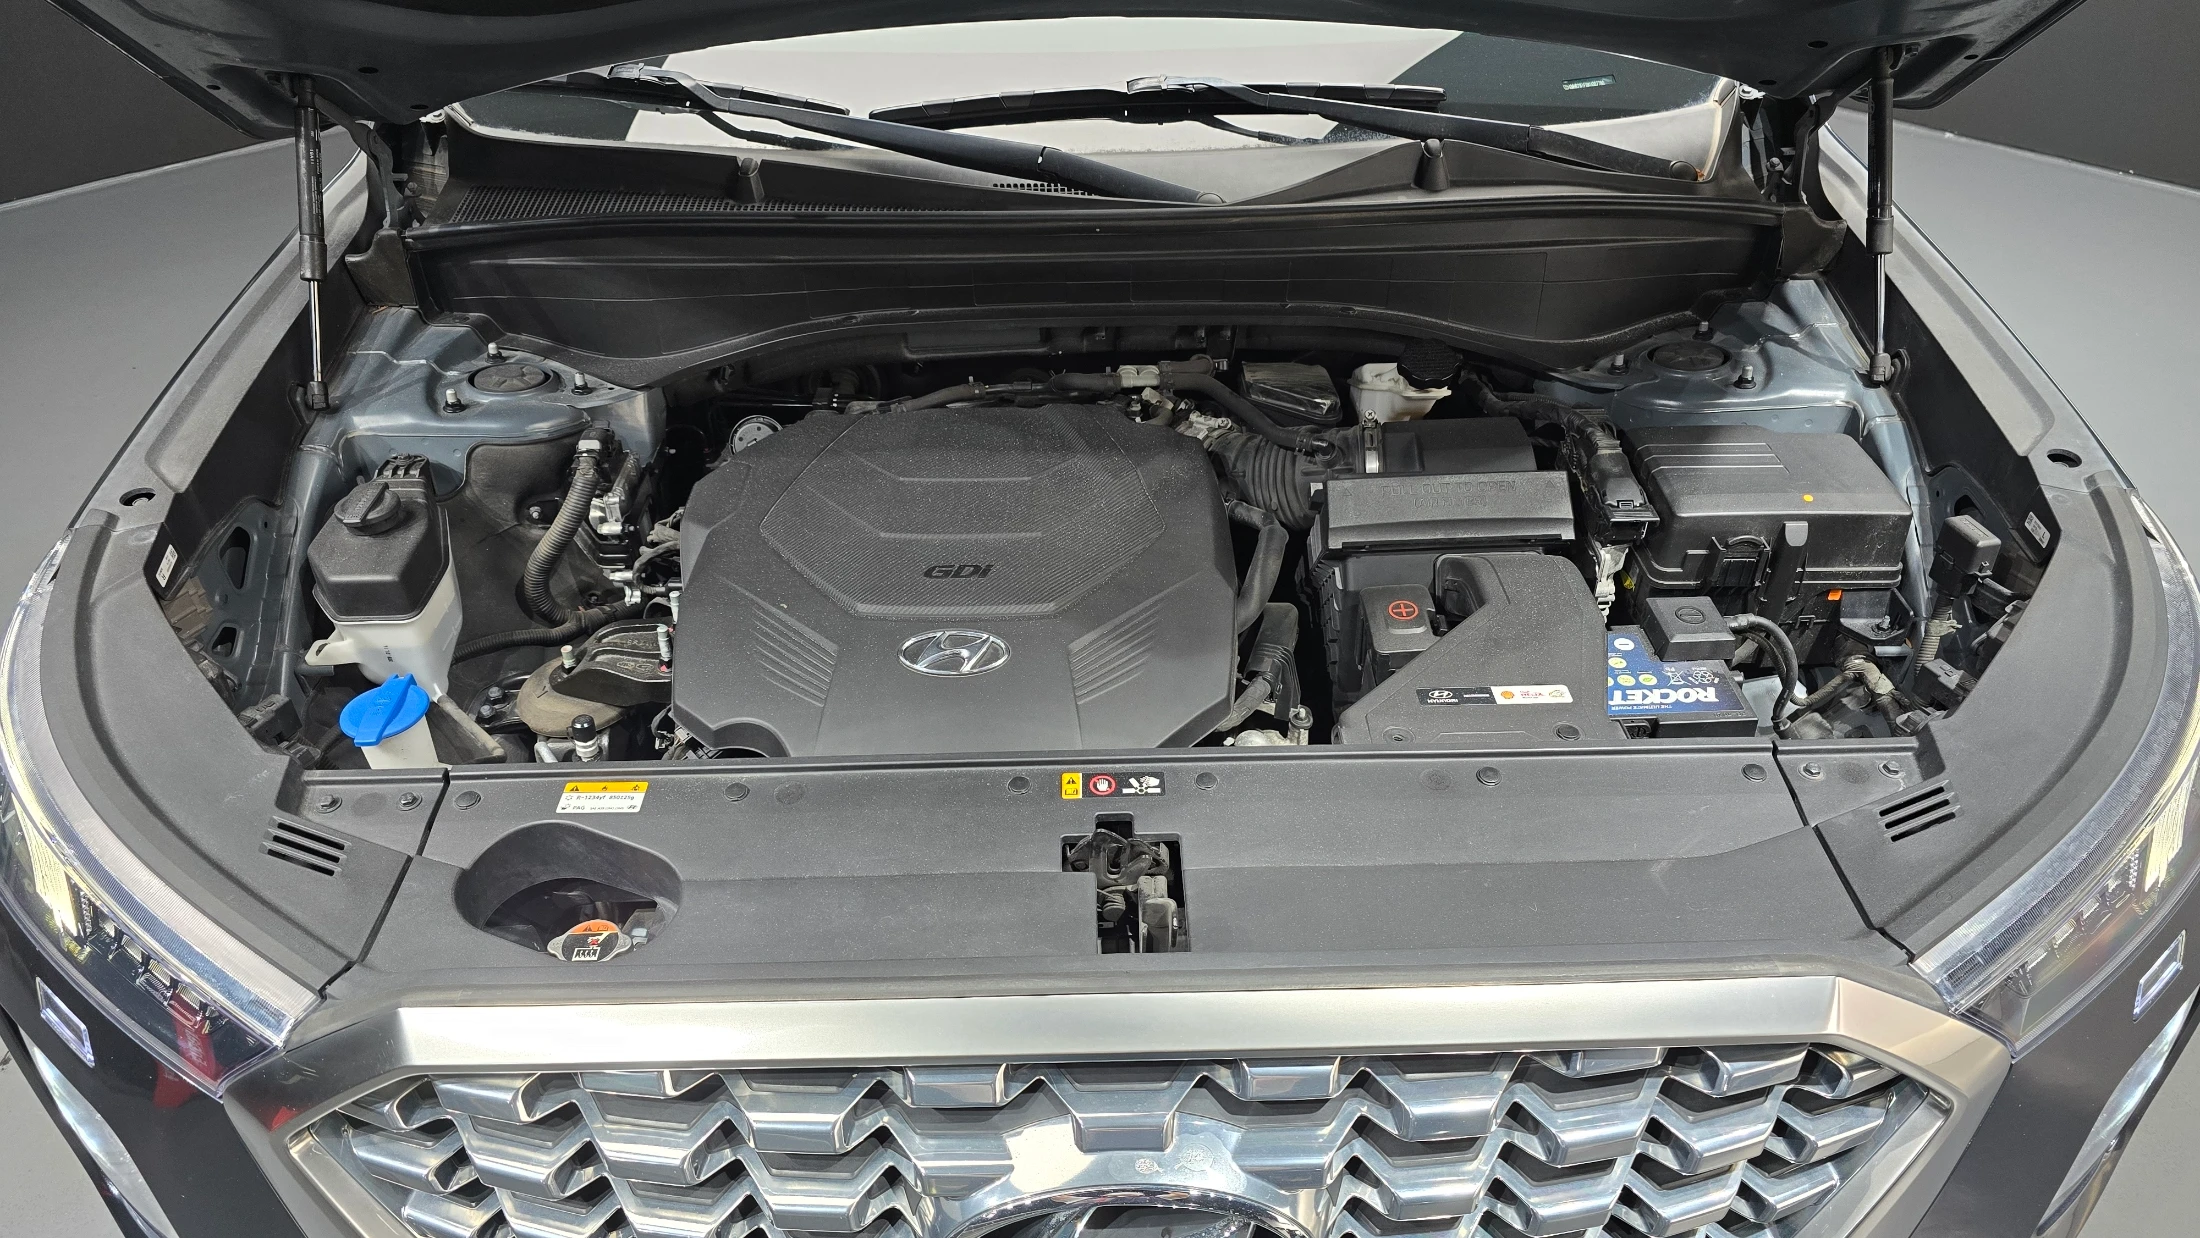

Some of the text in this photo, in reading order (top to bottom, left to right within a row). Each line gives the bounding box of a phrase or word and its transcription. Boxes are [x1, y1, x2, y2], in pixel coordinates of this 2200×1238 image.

[1381, 480, 1517, 498] PULL OUT TO OPEN
[1608, 686, 1720, 705] ROCKET
